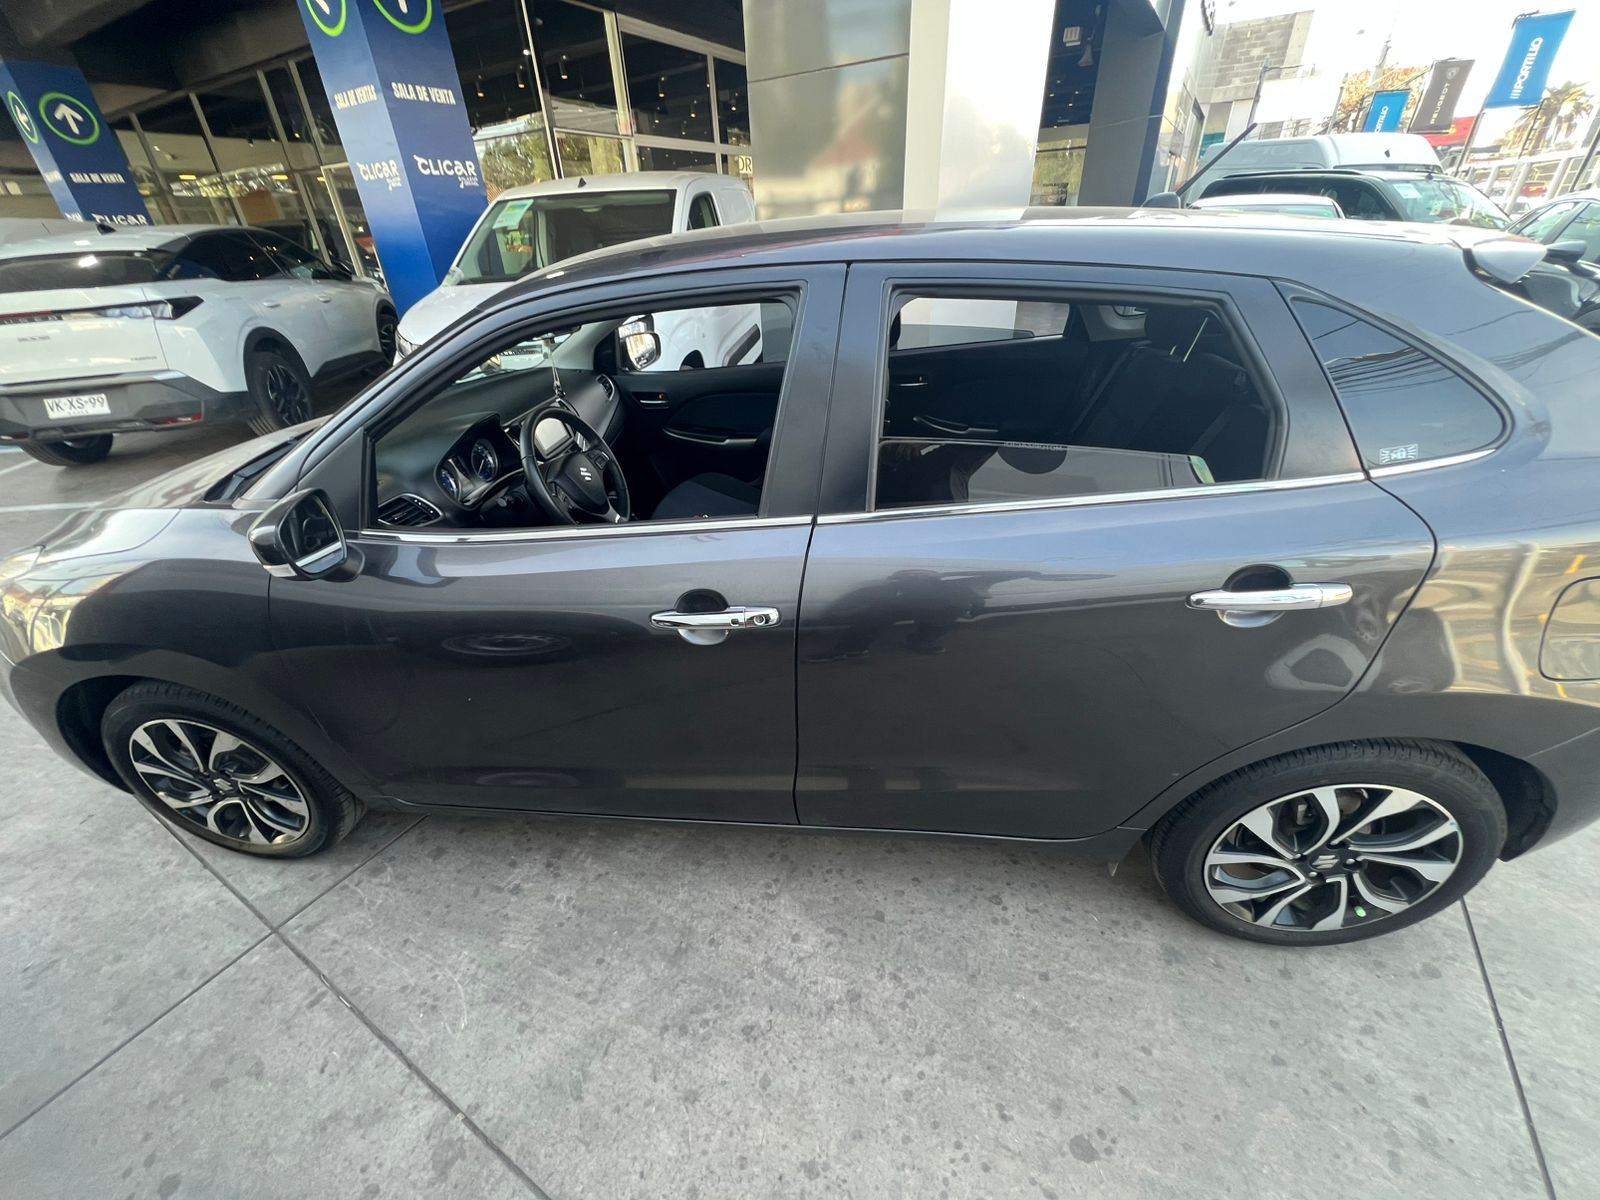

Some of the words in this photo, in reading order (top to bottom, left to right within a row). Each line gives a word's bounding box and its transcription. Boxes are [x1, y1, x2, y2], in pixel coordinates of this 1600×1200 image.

[391, 82, 417, 101] SALA
[415, 85, 430, 103] DE
[428, 87, 456, 105] VENTA
[1430, 82, 1451, 125] PEUGEOT
